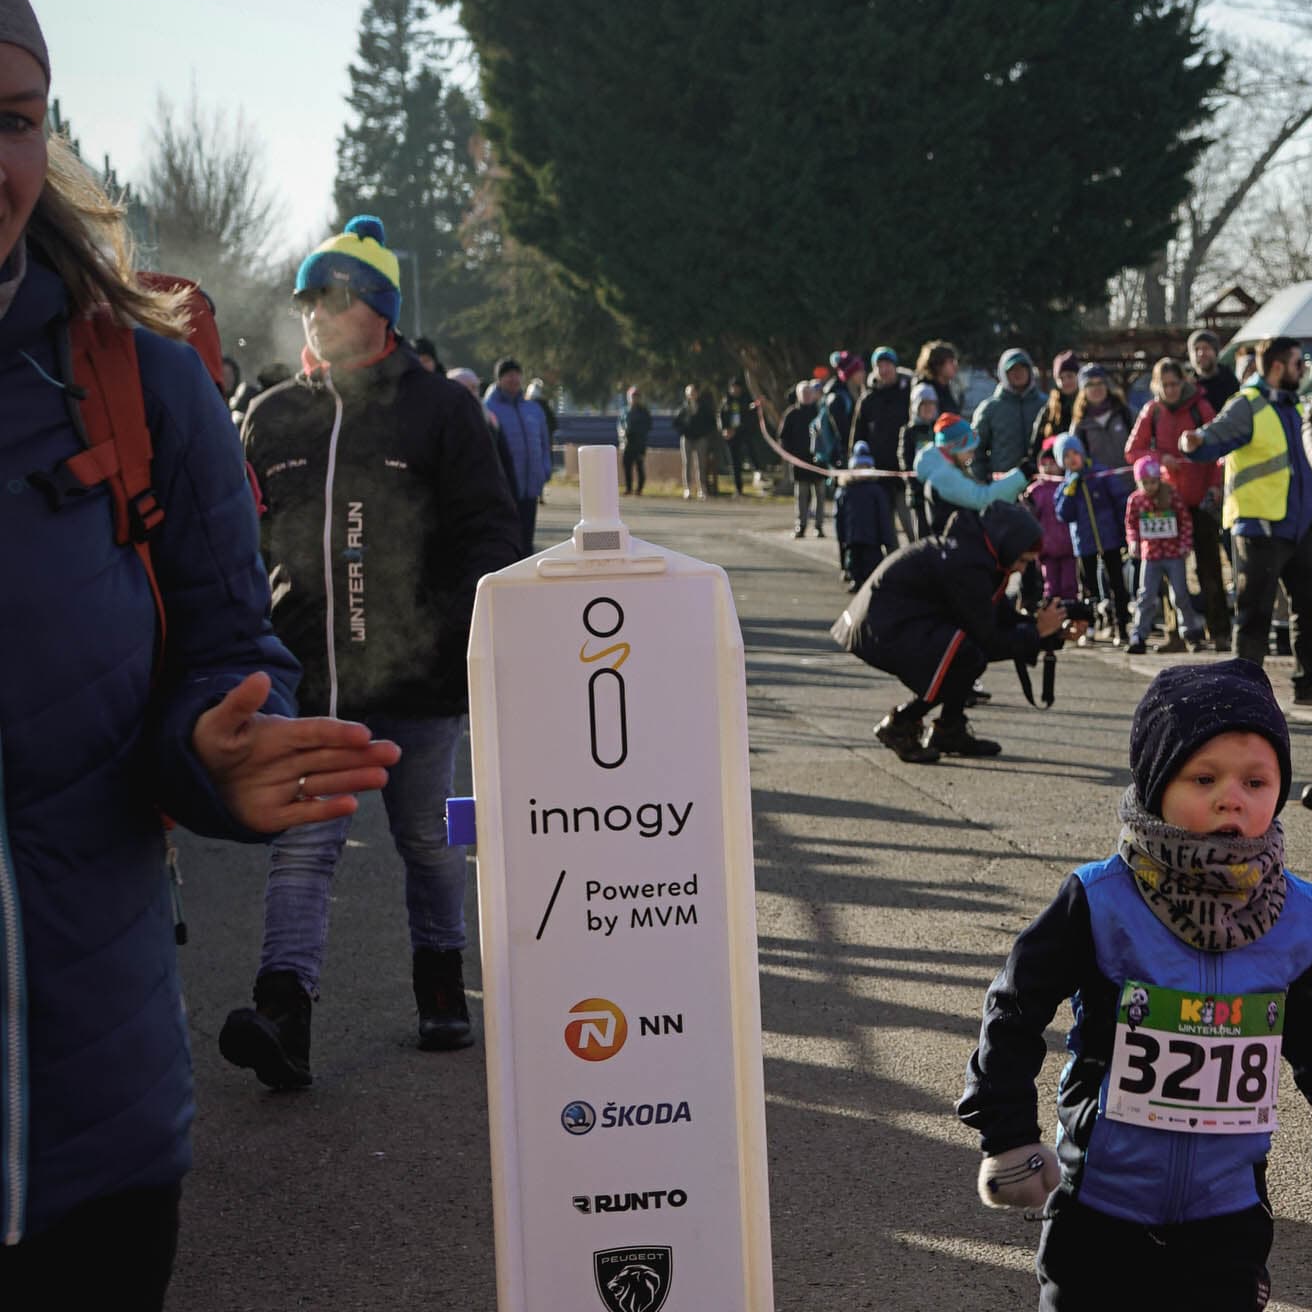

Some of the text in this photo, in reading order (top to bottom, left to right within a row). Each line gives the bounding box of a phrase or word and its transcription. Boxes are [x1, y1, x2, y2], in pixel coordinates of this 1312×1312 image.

[348, 501, 366, 642] WINTER RUN
[529, 798, 694, 838] innogy
[585, 874, 699, 901] Powered
[587, 904, 698, 936] by MVM
[639, 1014, 684, 1036] NN
[1119, 1031, 1268, 1104] 3218
[601, 1101, 691, 1128] ŠKODA
[595, 1189, 687, 1213] RUNTO
[601, 1252, 665, 1265] PEUGEOT
